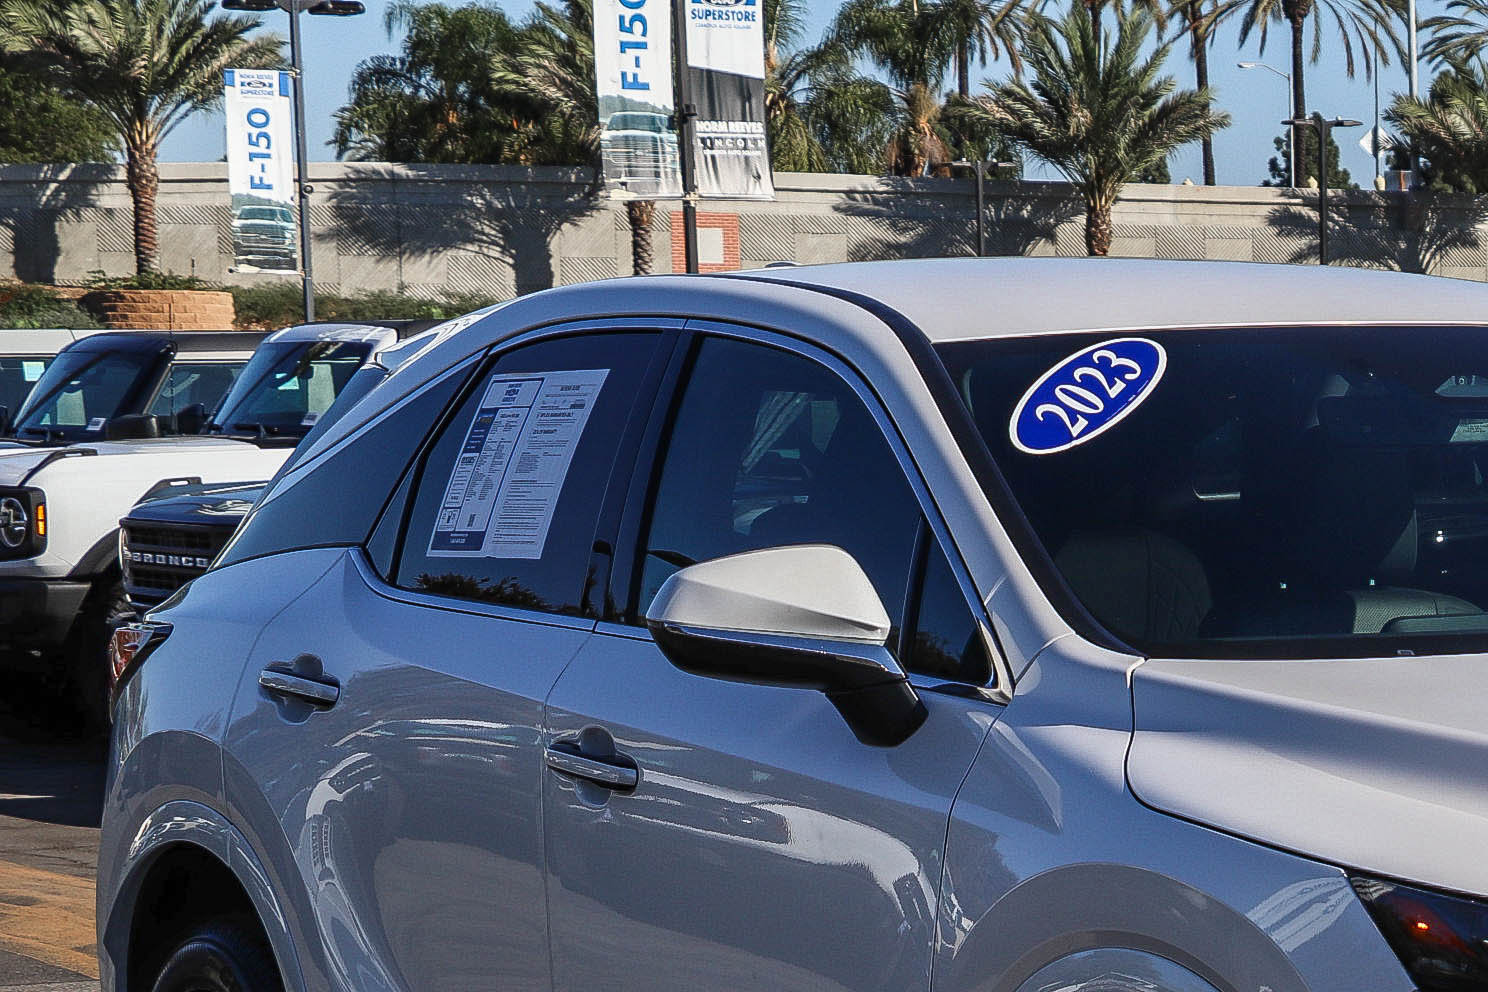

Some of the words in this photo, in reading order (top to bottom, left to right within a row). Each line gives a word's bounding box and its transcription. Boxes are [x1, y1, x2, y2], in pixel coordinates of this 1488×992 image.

[691, 8, 756, 22] SUPERSTORE
[696, 120, 728, 132] NORM
[729, 121, 764, 133] REEVES
[247, 107, 273, 190] F-150
[696, 138, 766, 149] LINCOLN
[1035, 349, 1142, 438] 2023
[132, 552, 209, 568] BRONCO
